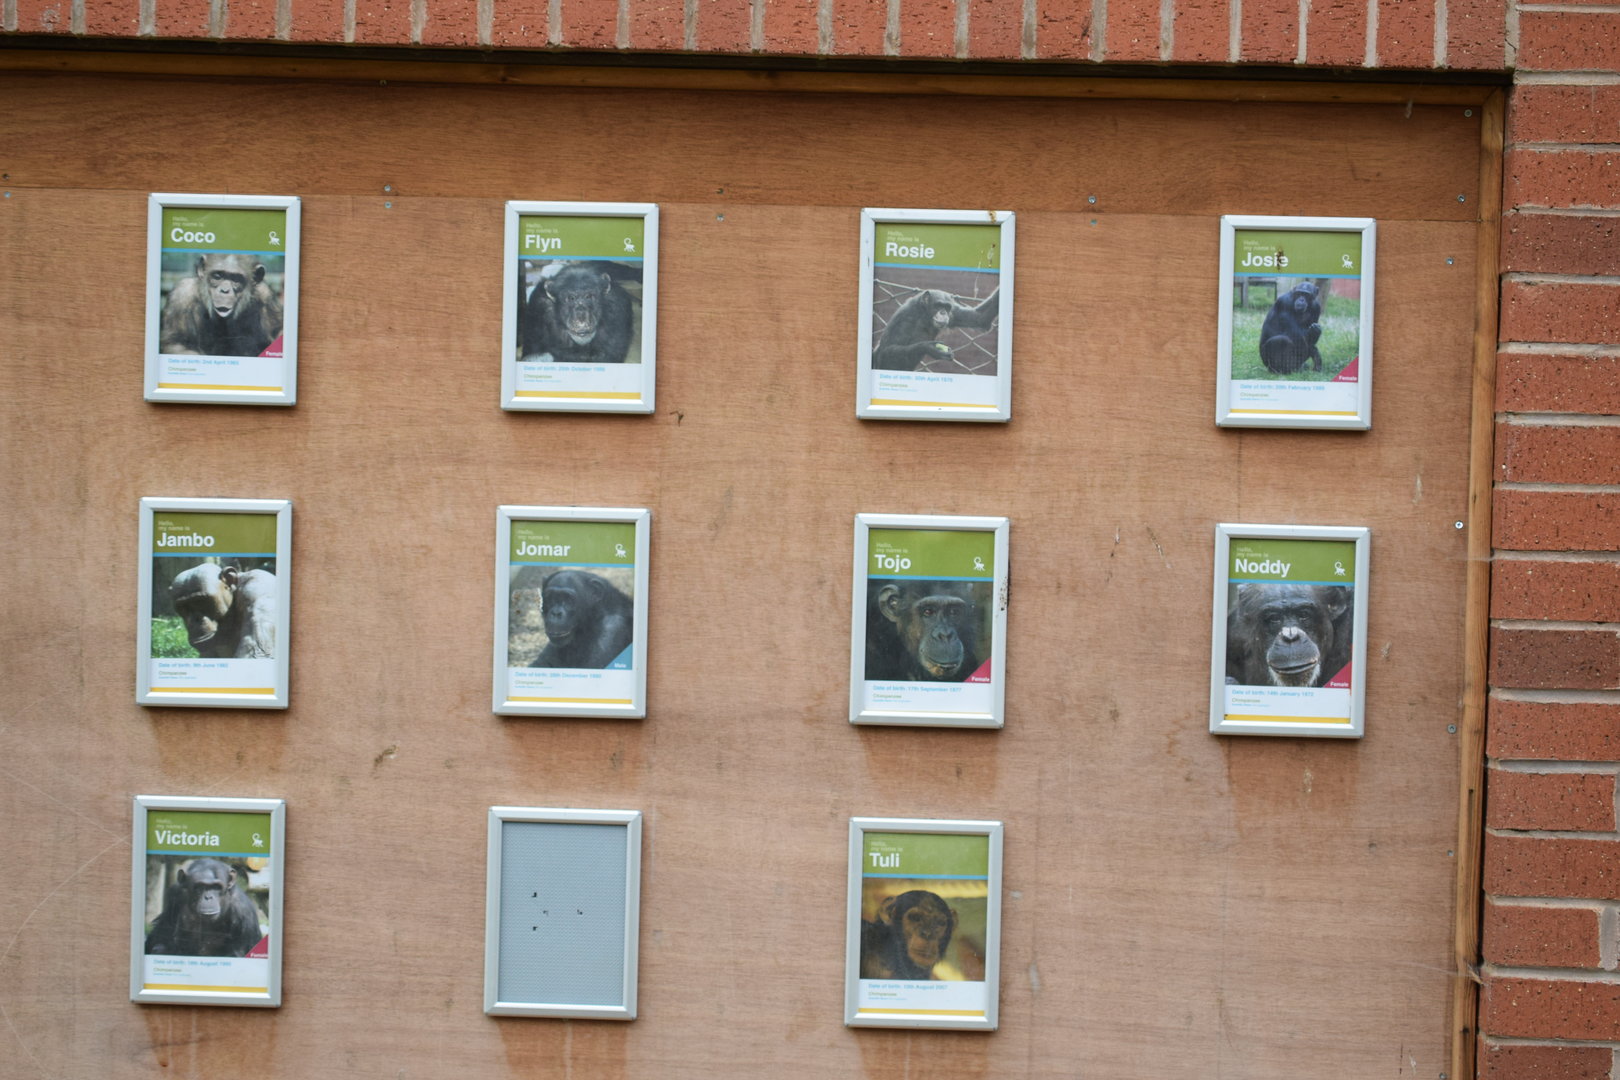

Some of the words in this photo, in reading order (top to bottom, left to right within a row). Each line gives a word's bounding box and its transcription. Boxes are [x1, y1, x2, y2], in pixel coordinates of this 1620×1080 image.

[171, 228, 216, 243] Coco
[525, 234, 562, 253] Flyn
[885, 242, 935, 259] Rosie
[1241, 252, 1289, 267] Josie
[157, 532, 215, 547] Jambo
[516, 541, 571, 556] Jomar
[874, 554, 912, 573] Tojo
[1235, 558, 1291, 578] Noddy
[155, 830, 220, 846] Victoria
[869, 852, 900, 867] Tuli
